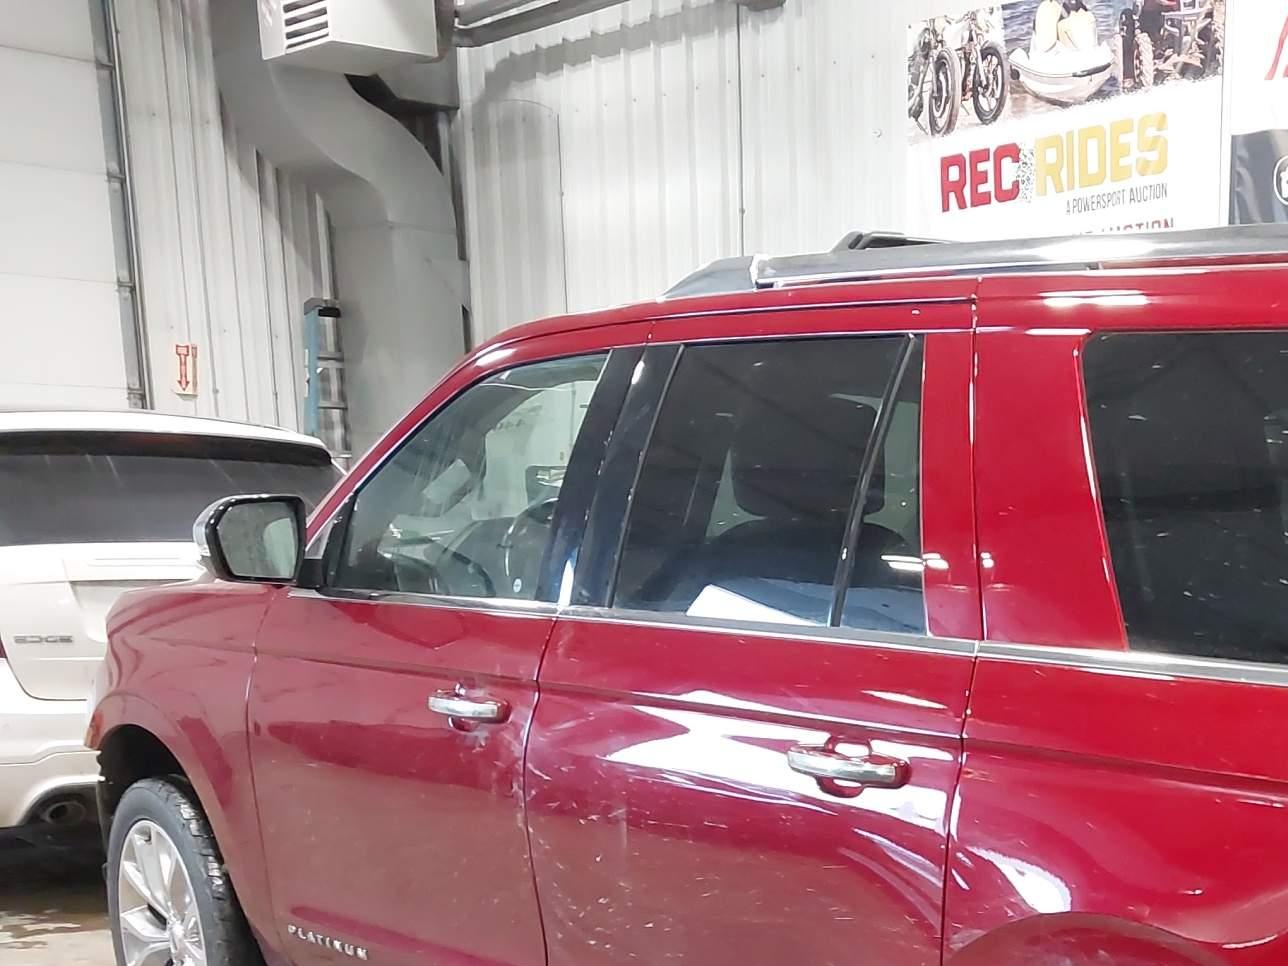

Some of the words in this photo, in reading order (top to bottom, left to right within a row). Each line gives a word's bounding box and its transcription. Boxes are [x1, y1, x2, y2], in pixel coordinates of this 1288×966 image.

[940, 143, 1021, 212] REC
[1034, 111, 1169, 197] RIDES
[1065, 199, 1071, 216] A
[1072, 188, 1126, 214] POWERSPORT
[1129, 182, 1168, 205] AUCTION
[287, 924, 368, 960] PLATINUM
